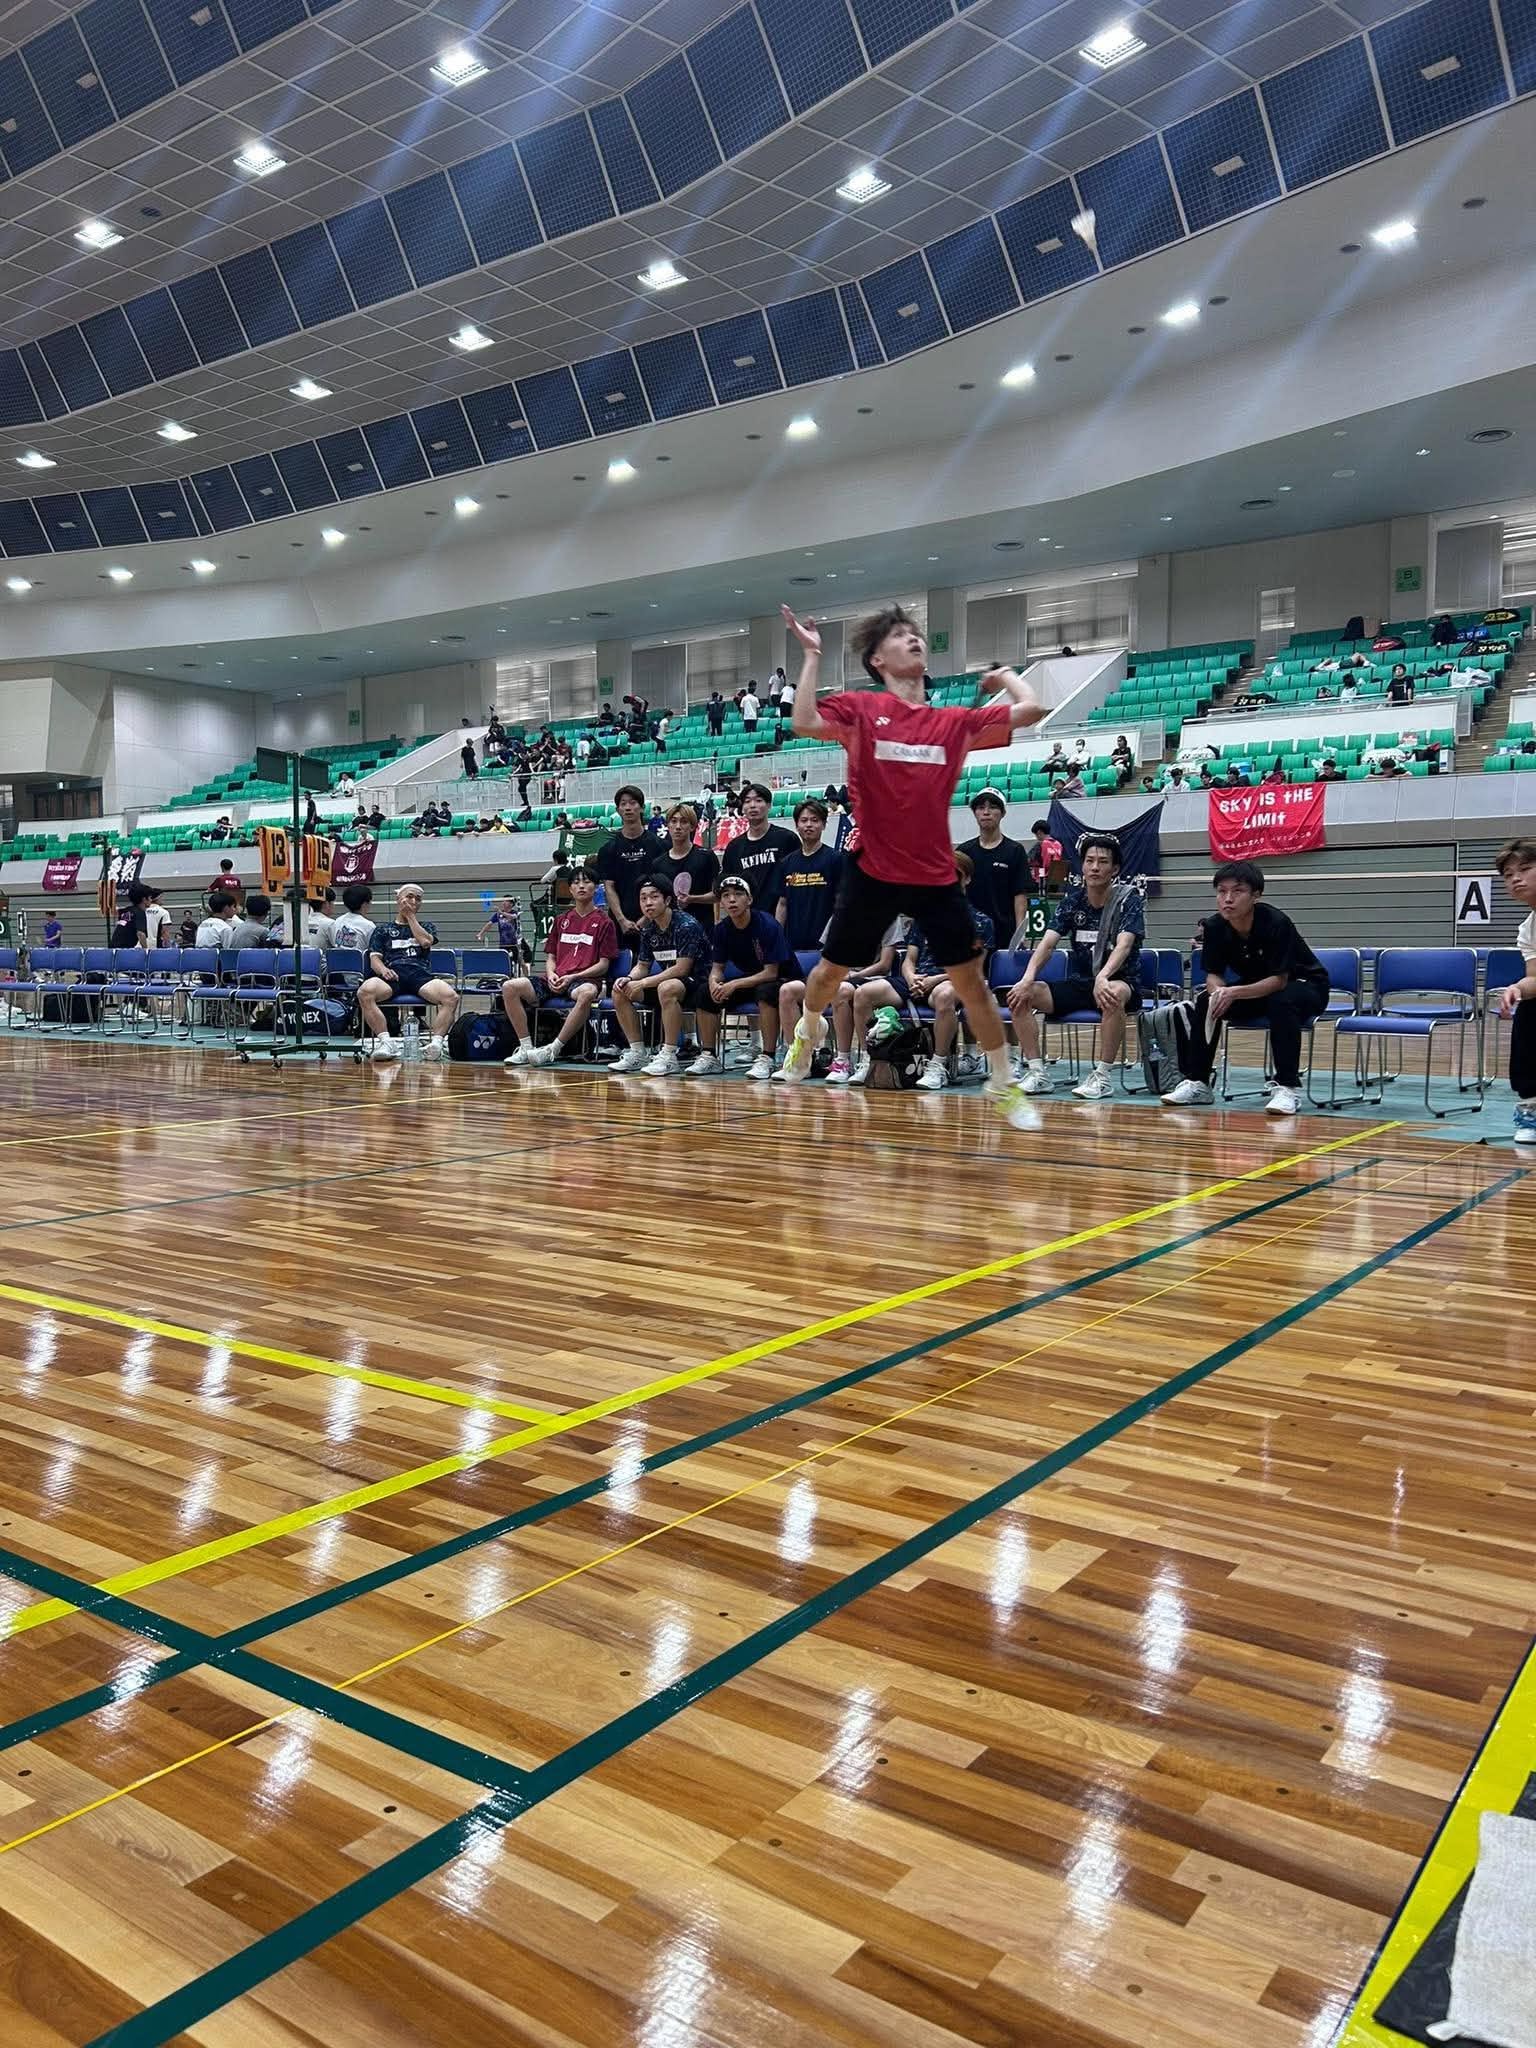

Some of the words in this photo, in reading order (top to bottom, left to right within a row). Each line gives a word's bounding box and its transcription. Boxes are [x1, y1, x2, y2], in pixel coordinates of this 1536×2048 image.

[1219, 796, 1253, 813] SKY
[1259, 791, 1276, 806] IS
[271, 833, 286, 867] 13
[740, 851, 776, 870] KEIWA
[1458, 881, 1489, 920] A
[1025, 910, 1046, 933] 13
